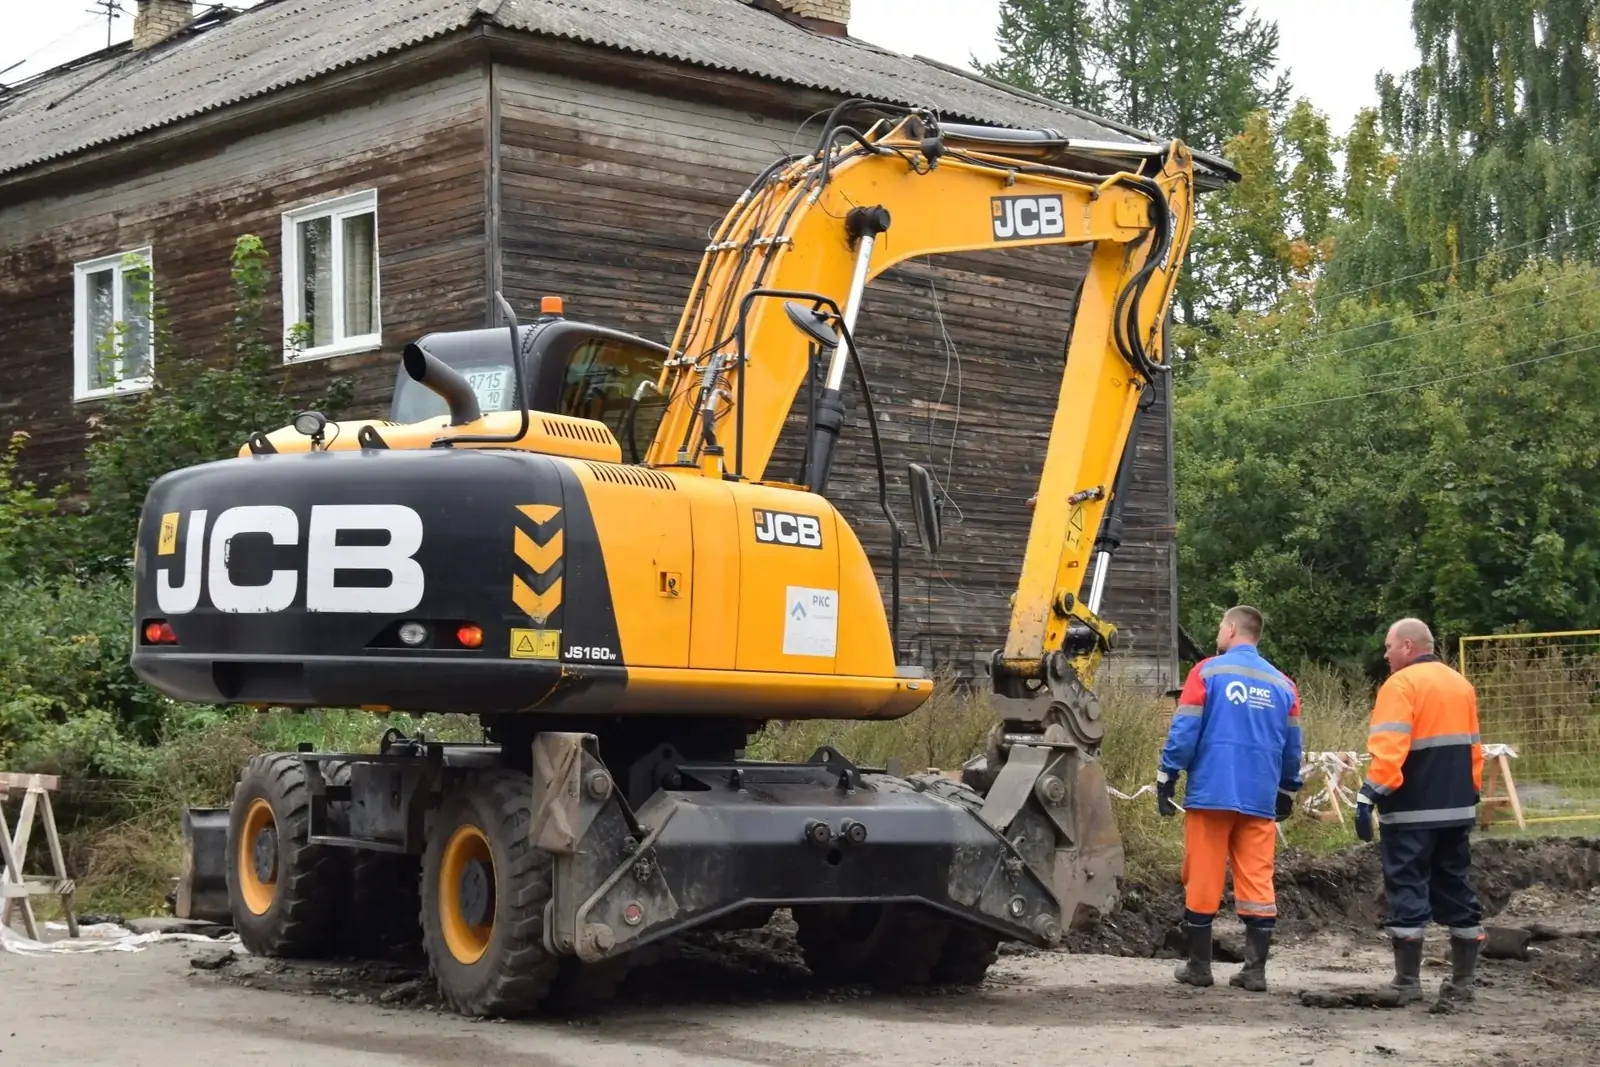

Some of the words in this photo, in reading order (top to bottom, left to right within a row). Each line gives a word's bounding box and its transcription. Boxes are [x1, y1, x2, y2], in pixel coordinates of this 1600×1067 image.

[993, 197, 1064, 238] JCB
[487, 391, 500, 404] 10
[756, 512, 822, 547] JCB
[156, 504, 425, 614] JCB
